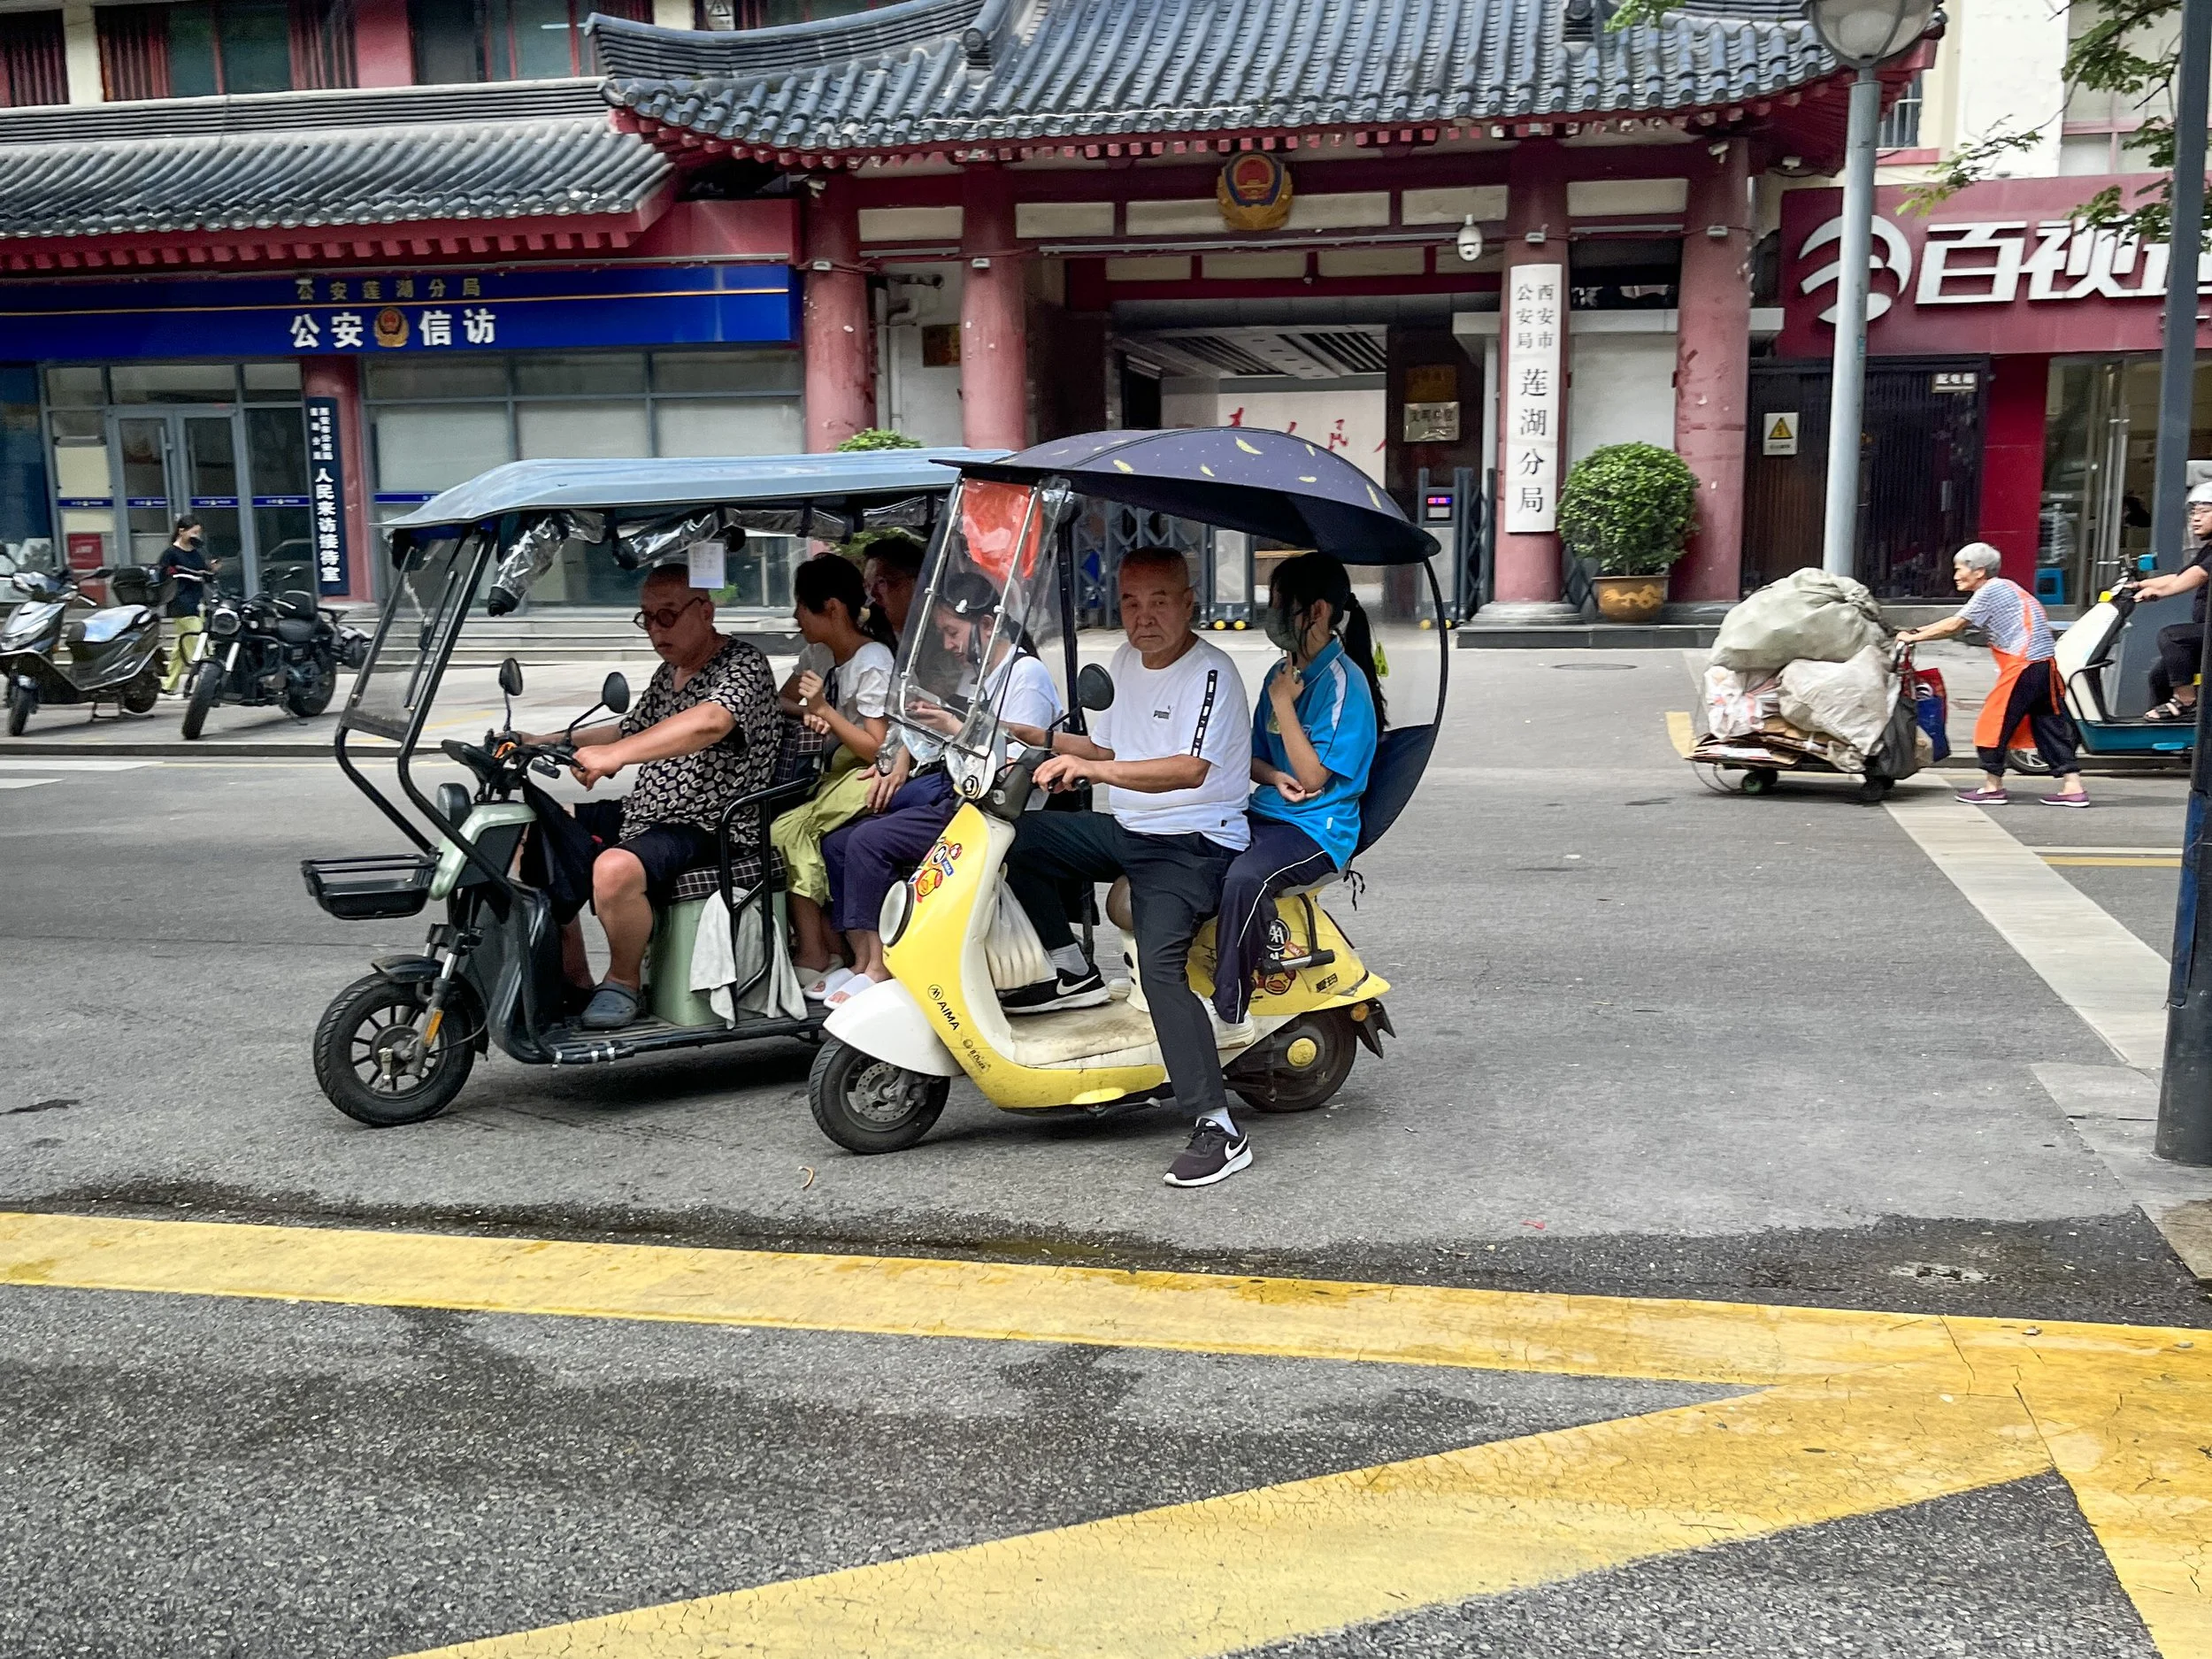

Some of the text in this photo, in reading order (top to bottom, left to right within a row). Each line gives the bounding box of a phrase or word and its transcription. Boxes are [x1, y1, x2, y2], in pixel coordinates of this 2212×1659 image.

[296, 278, 480, 301] 公安莲湖分局
[1516, 283, 1533, 349] 公安局
[1537, 283, 1556, 349] 西安市
[1517, 368, 1548, 513] 莲湖分局
[937, 1002, 960, 1031] AIMA
